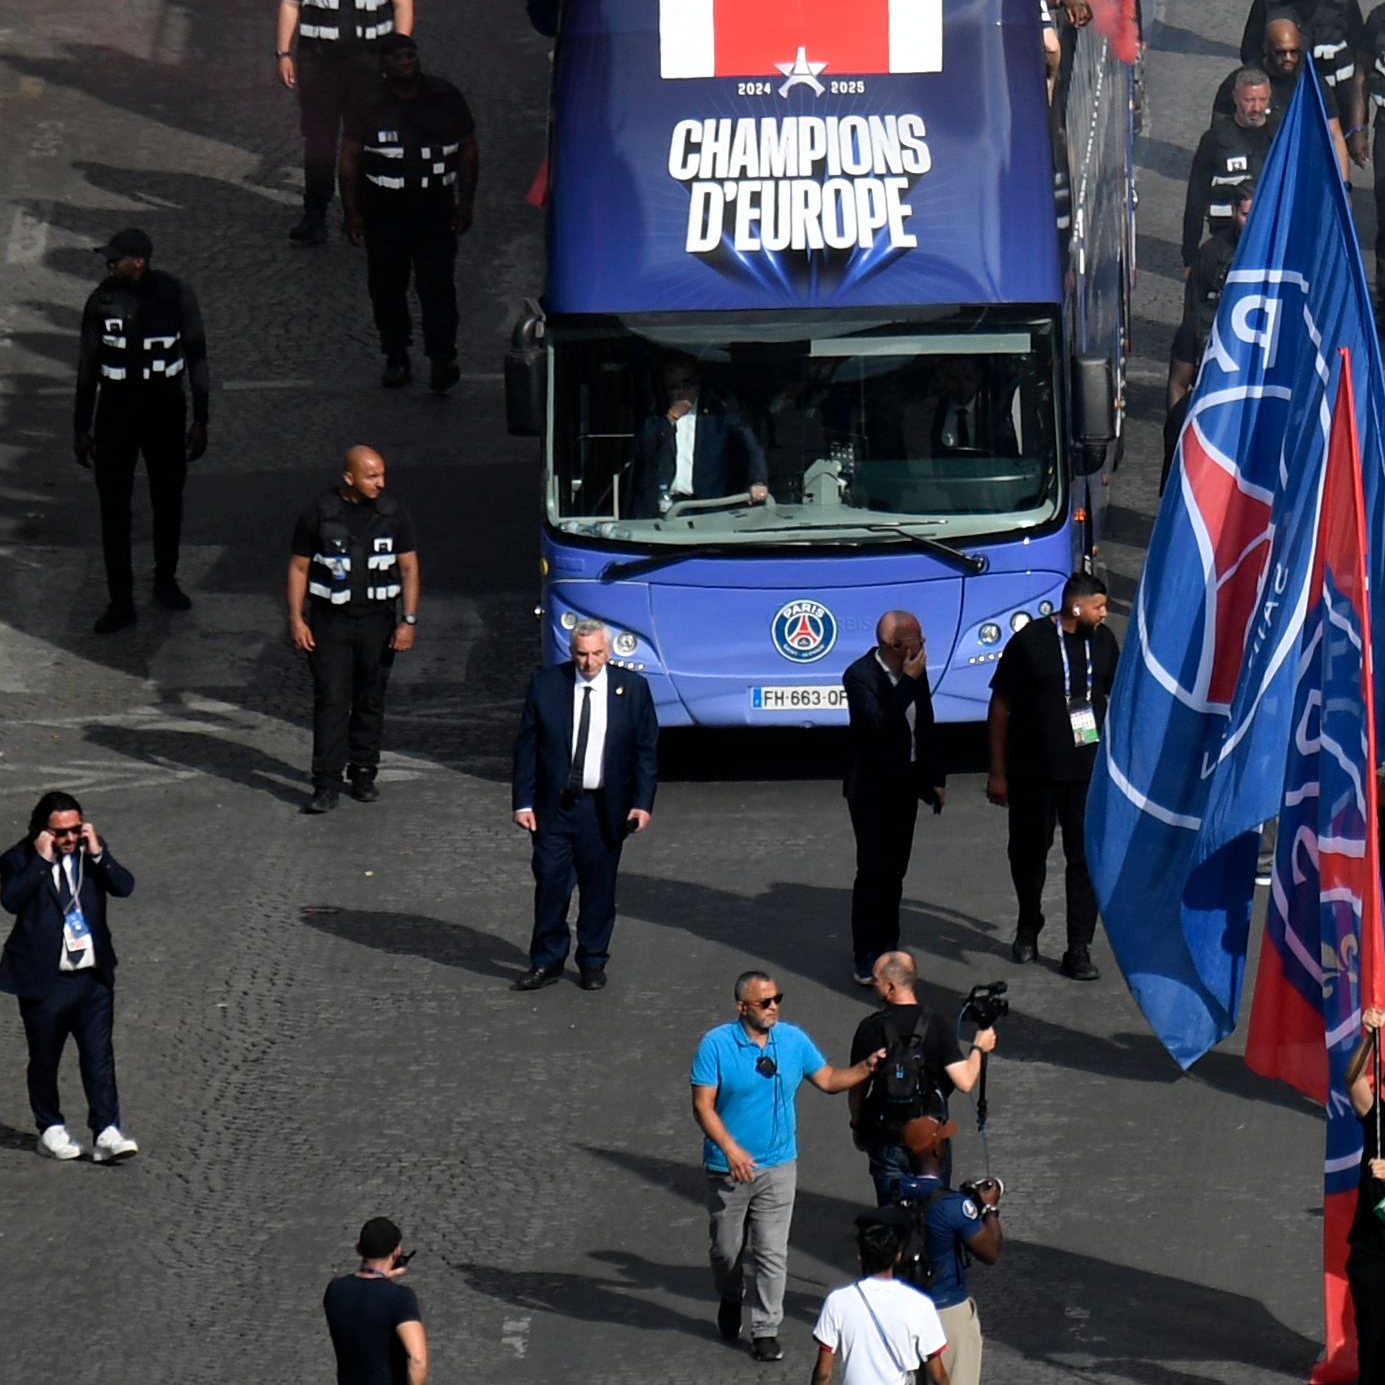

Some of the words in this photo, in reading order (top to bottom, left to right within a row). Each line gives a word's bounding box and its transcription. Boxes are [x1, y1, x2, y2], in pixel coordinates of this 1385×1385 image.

[738, 83, 771, 95] 2024
[831, 82, 865, 94] 2025
[667, 114, 932, 181] CHAMPIONS
[686, 179, 918, 254] D'EUROPE
[782, 602, 825, 619] PARIS
